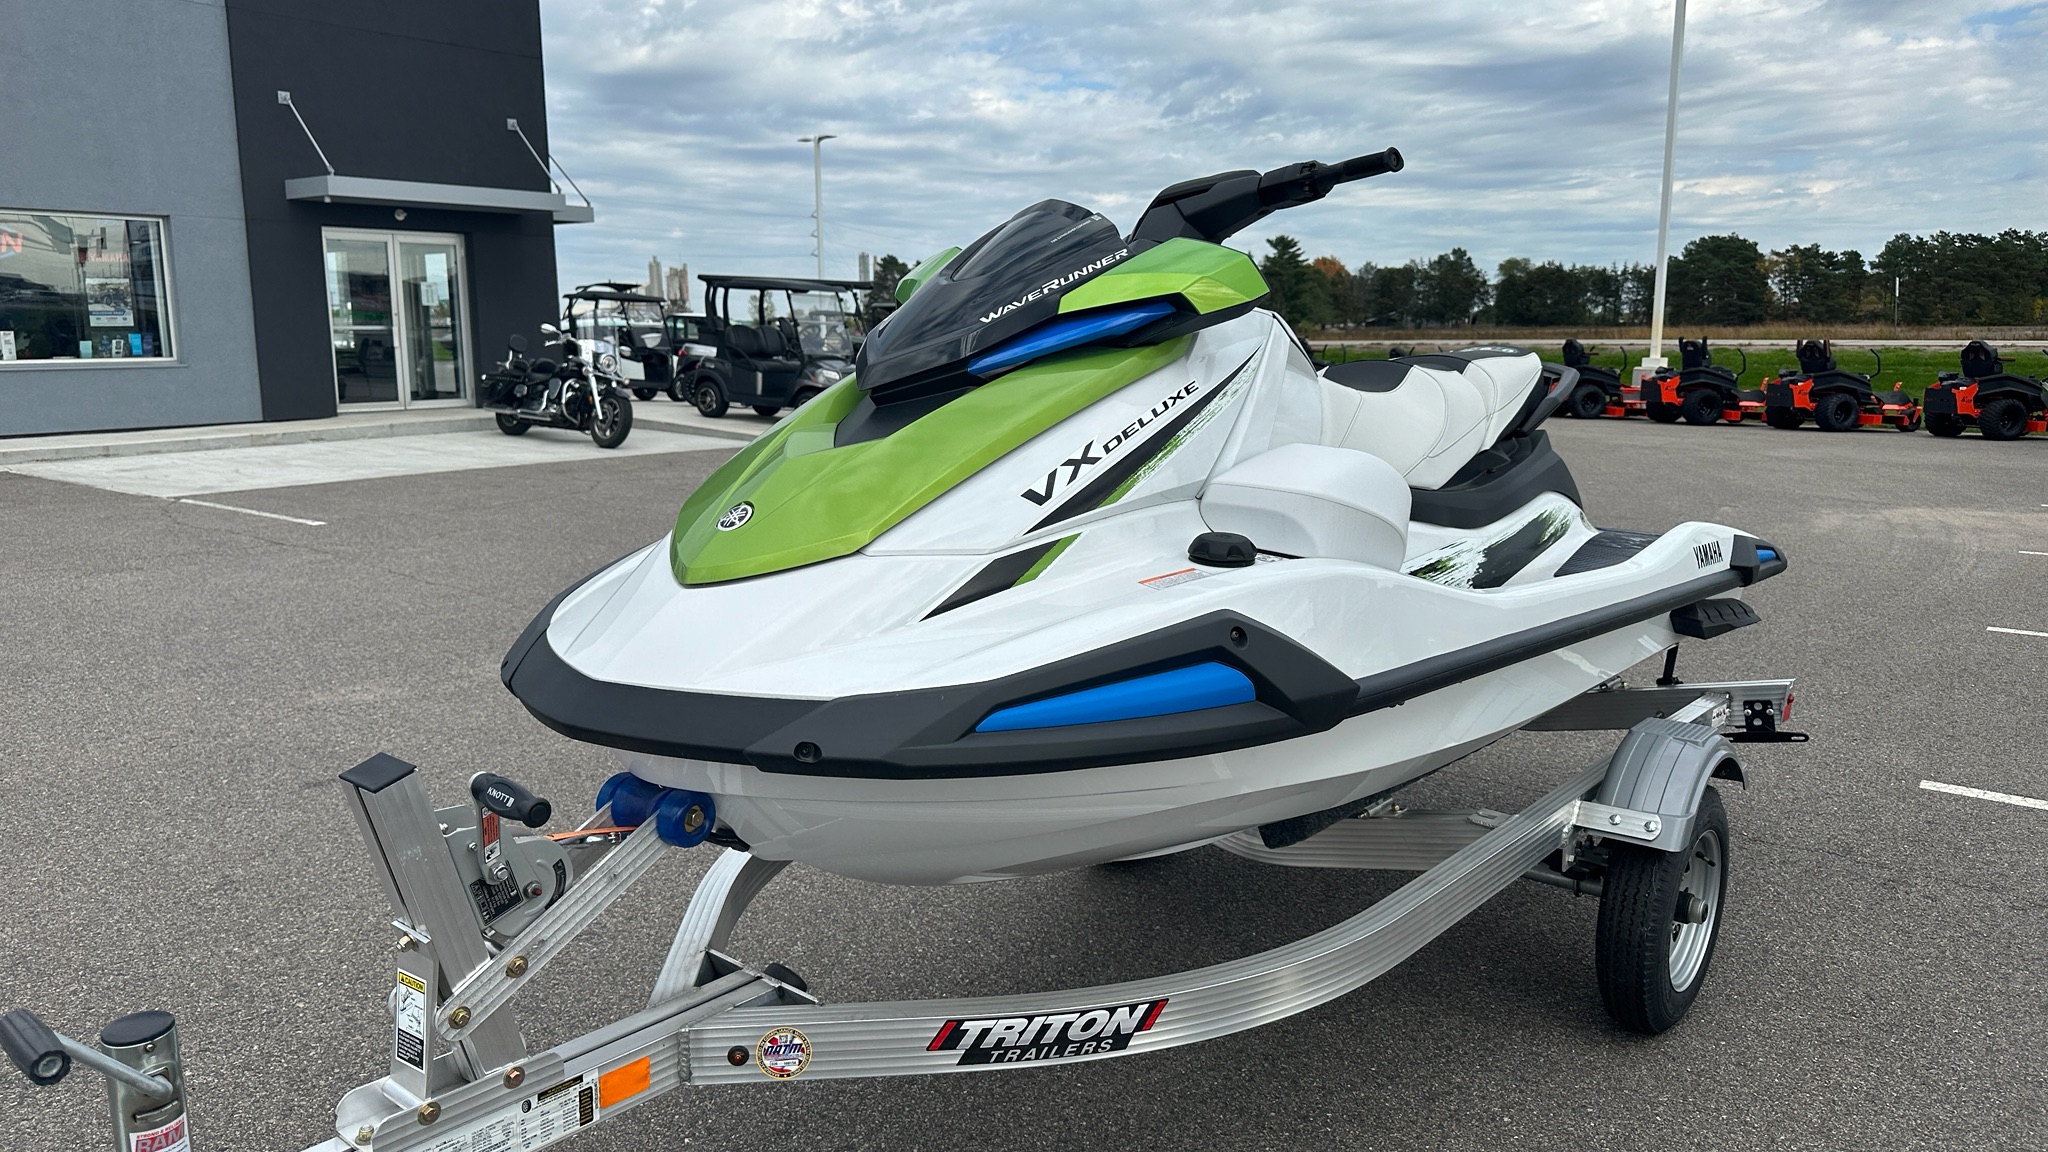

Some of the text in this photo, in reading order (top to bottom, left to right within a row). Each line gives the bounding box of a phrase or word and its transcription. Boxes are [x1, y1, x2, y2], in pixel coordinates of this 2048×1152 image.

[979, 248, 1129, 324] WAVERUNNER
[1020, 380, 1200, 506] VX DELUXE
[1692, 540, 1724, 569] YAMAHA
[486, 786, 511, 804] KNOTT
[404, 976, 424, 990] CAUTION
[957, 1003, 1150, 1050] TRITON
[989, 1038, 1113, 1063] TRAILERS
[136, 1122, 185, 1152] RAM
